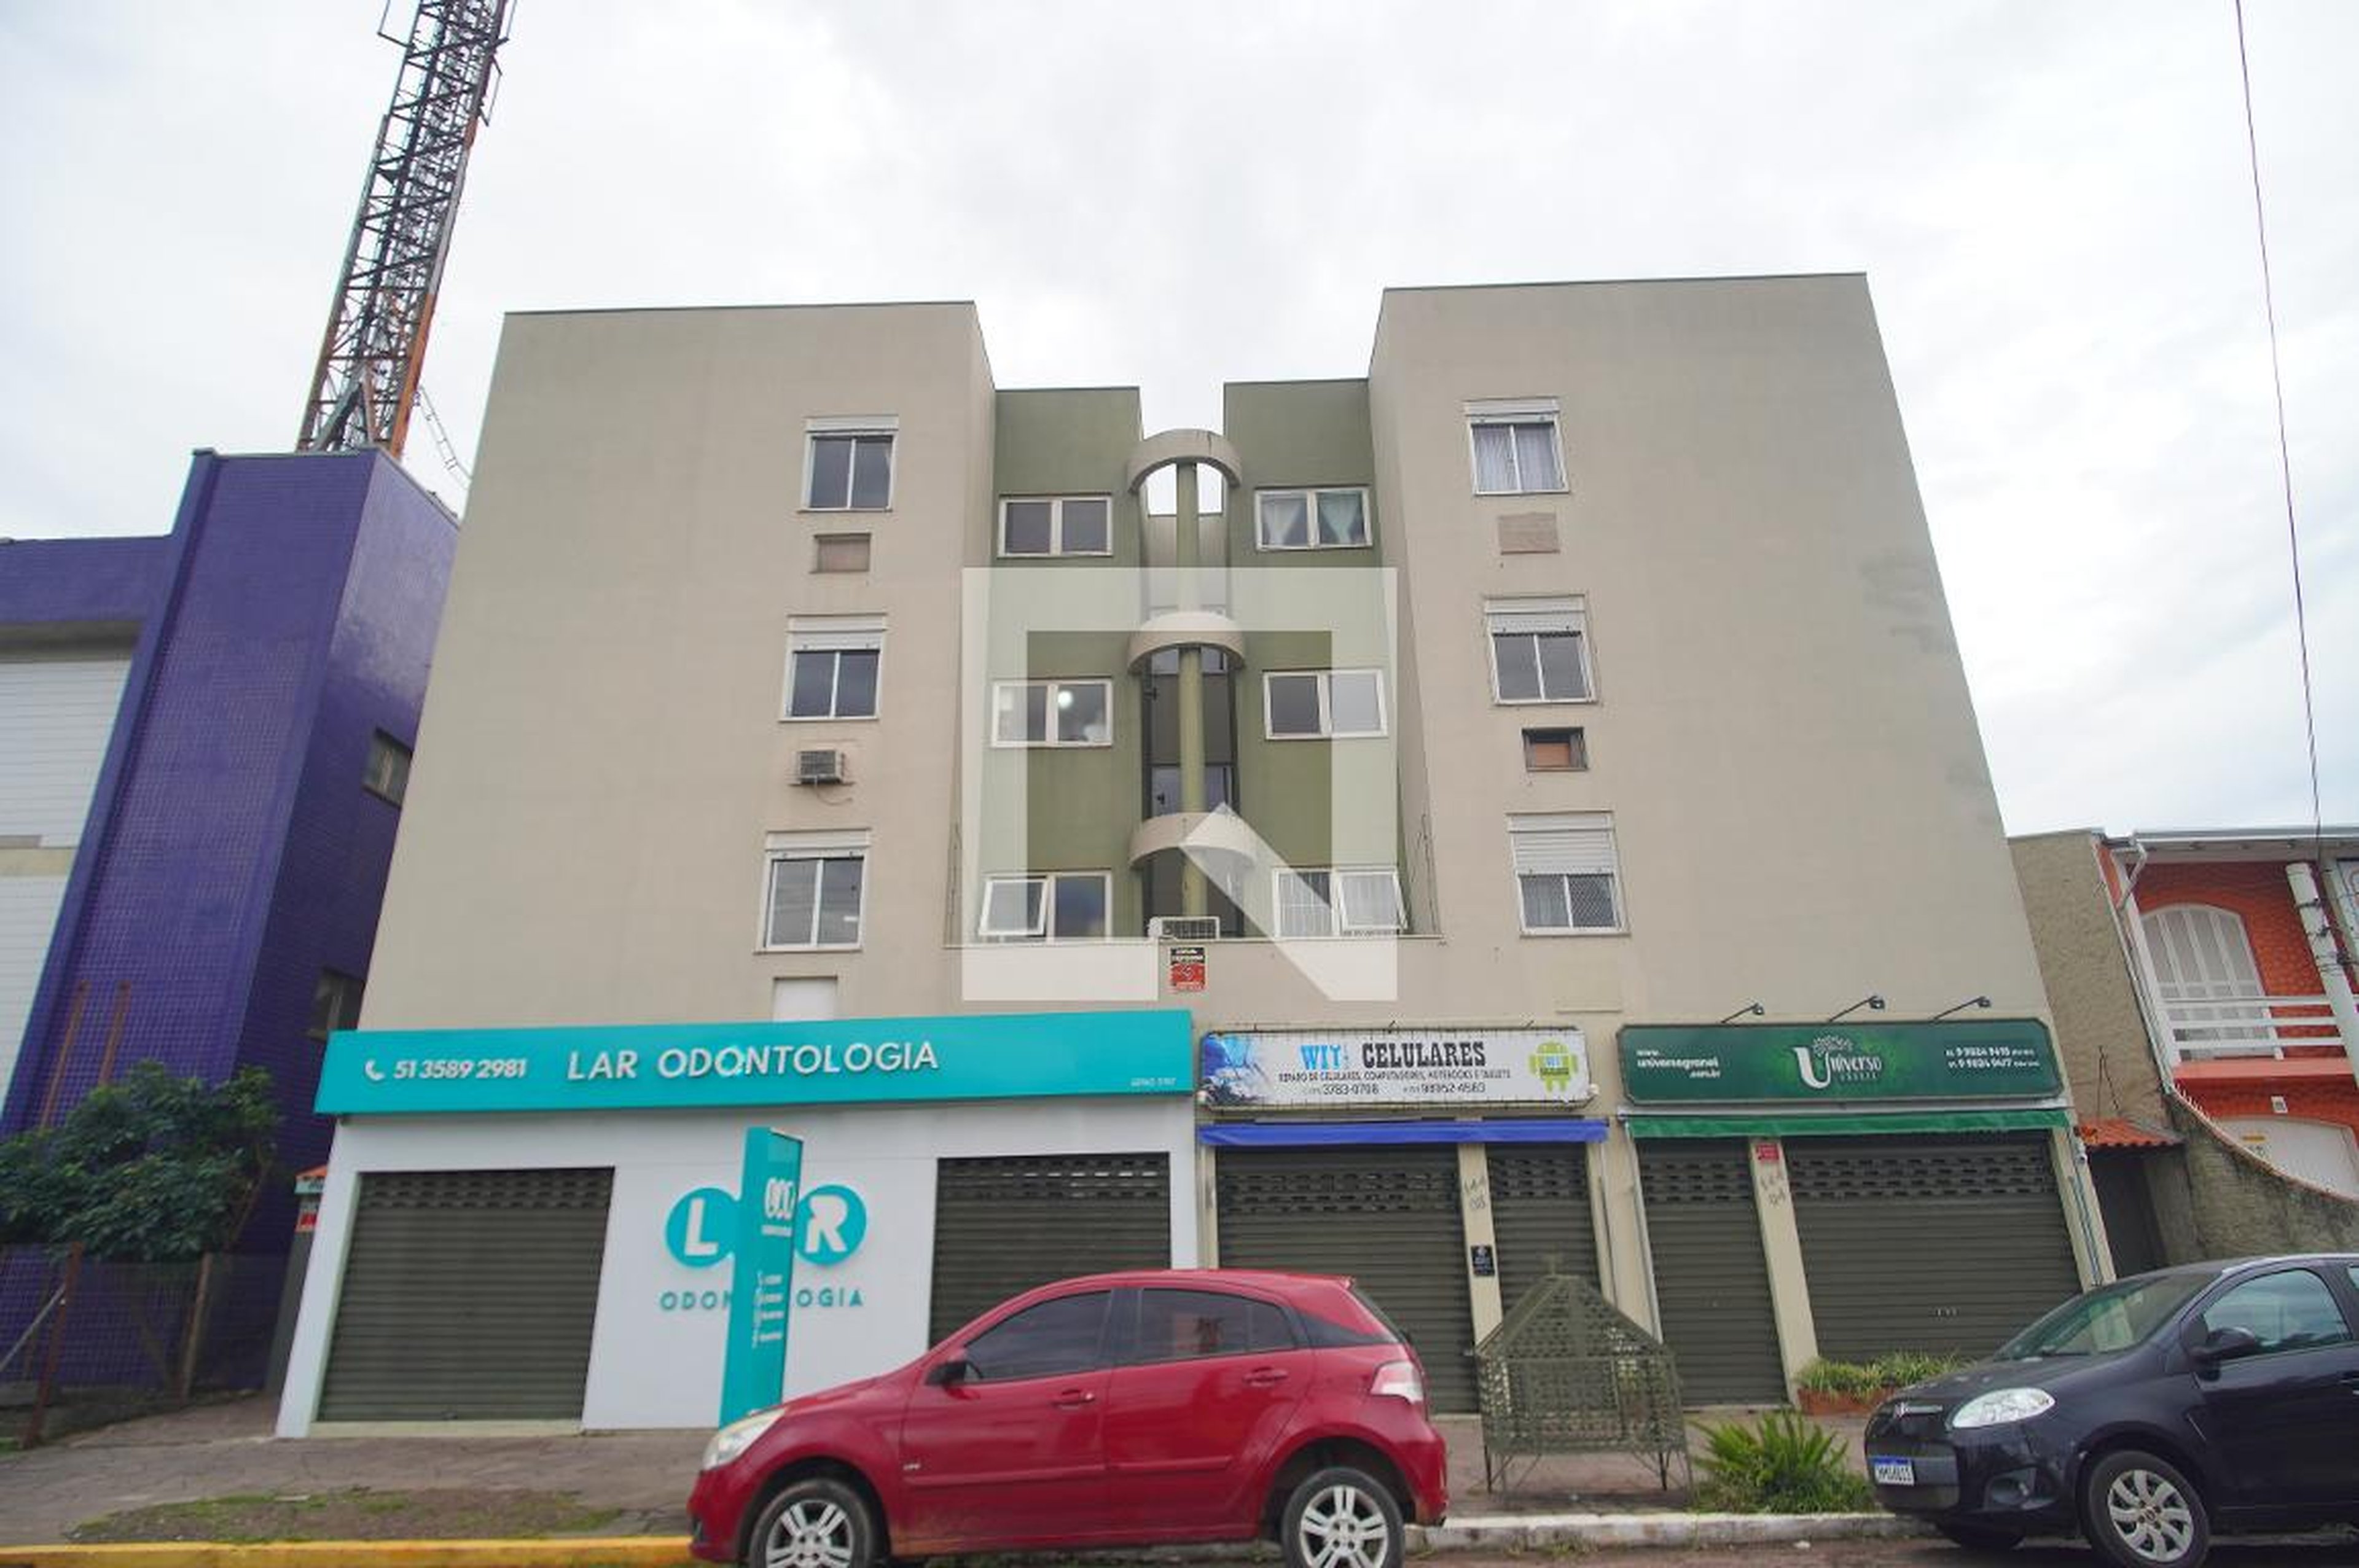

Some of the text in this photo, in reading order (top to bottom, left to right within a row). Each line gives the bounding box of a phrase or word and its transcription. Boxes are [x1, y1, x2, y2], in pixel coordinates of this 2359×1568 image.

[393, 1041, 939, 1080] 51 3589 2981 LAR ODONTOLOGIA
[1361, 1042, 1485, 1069] CELULARES
